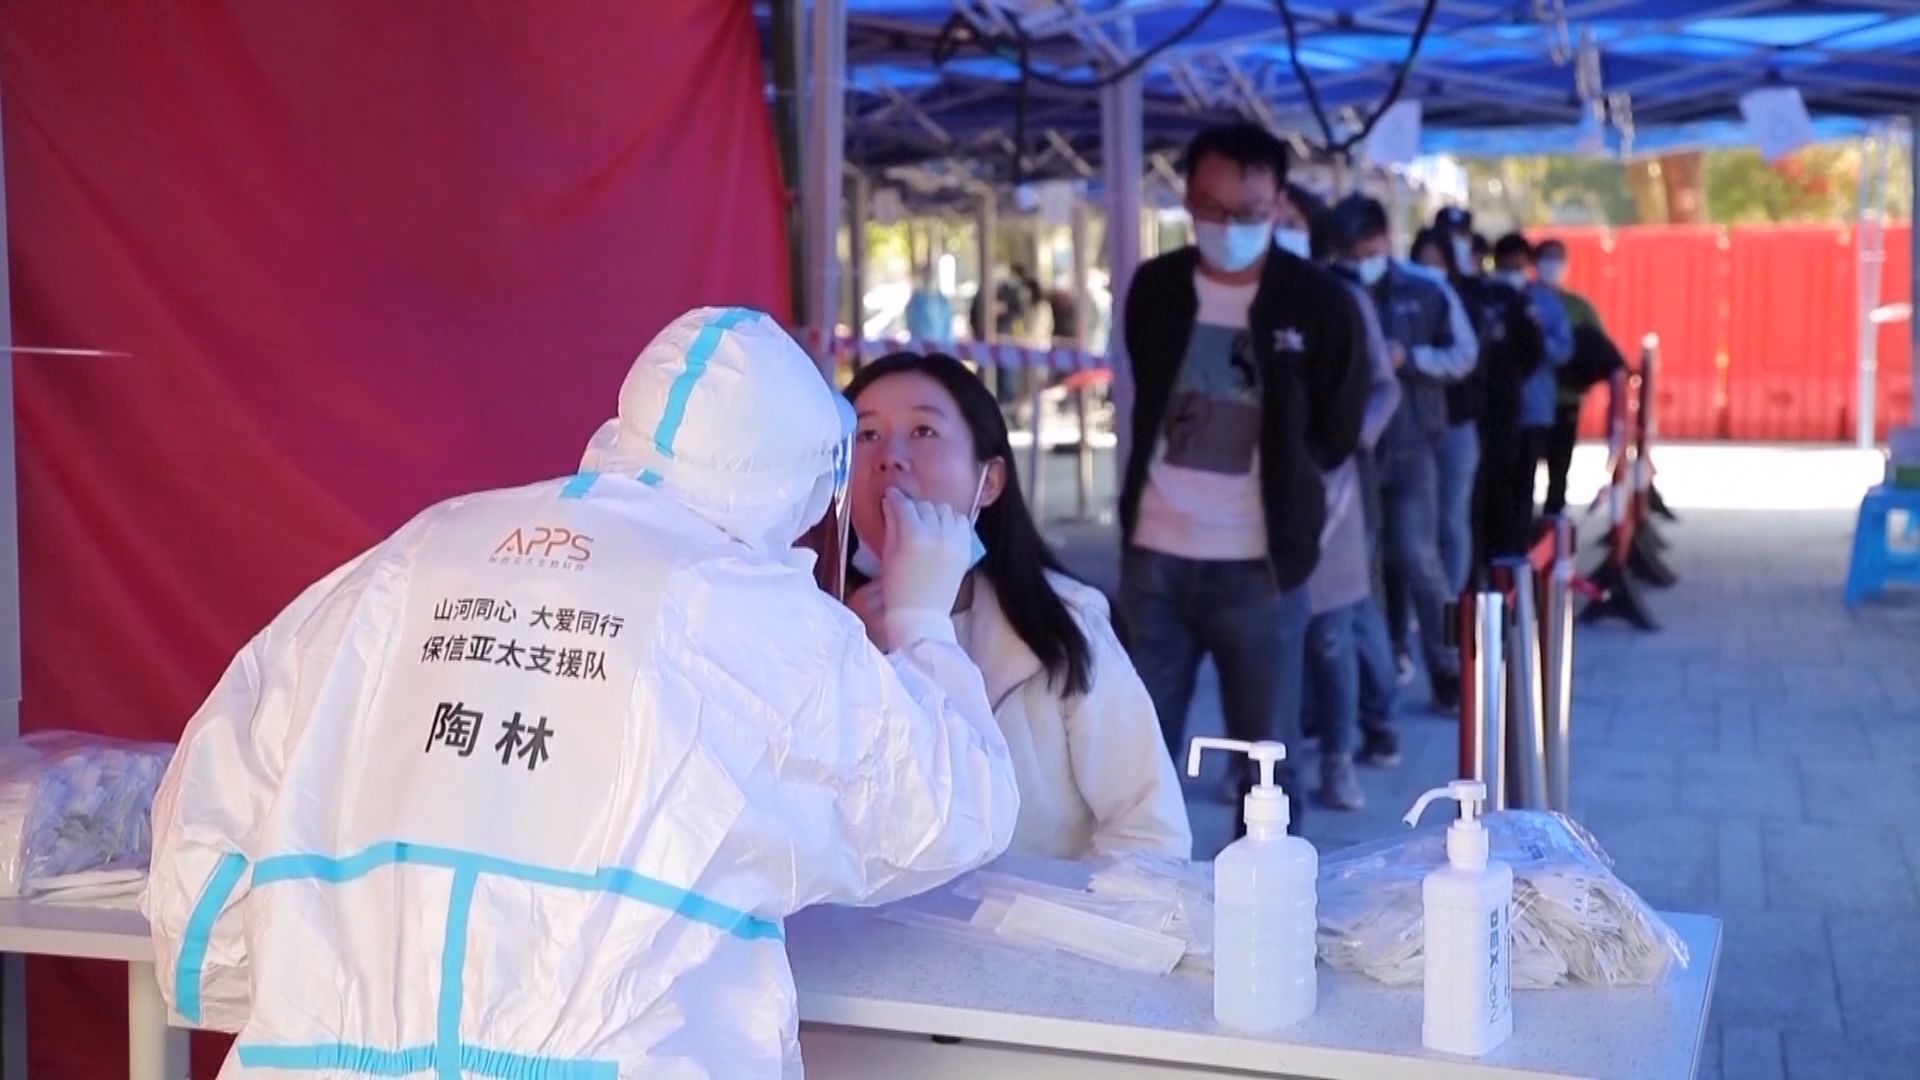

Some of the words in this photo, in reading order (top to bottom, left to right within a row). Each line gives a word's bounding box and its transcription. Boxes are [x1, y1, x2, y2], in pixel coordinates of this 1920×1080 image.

[494, 527, 594, 562] APPS
[434, 598, 517, 623] 山河同心
[529, 605, 625, 638] 大爱同行
[421, 634, 608, 681] 保信亚太支援队
